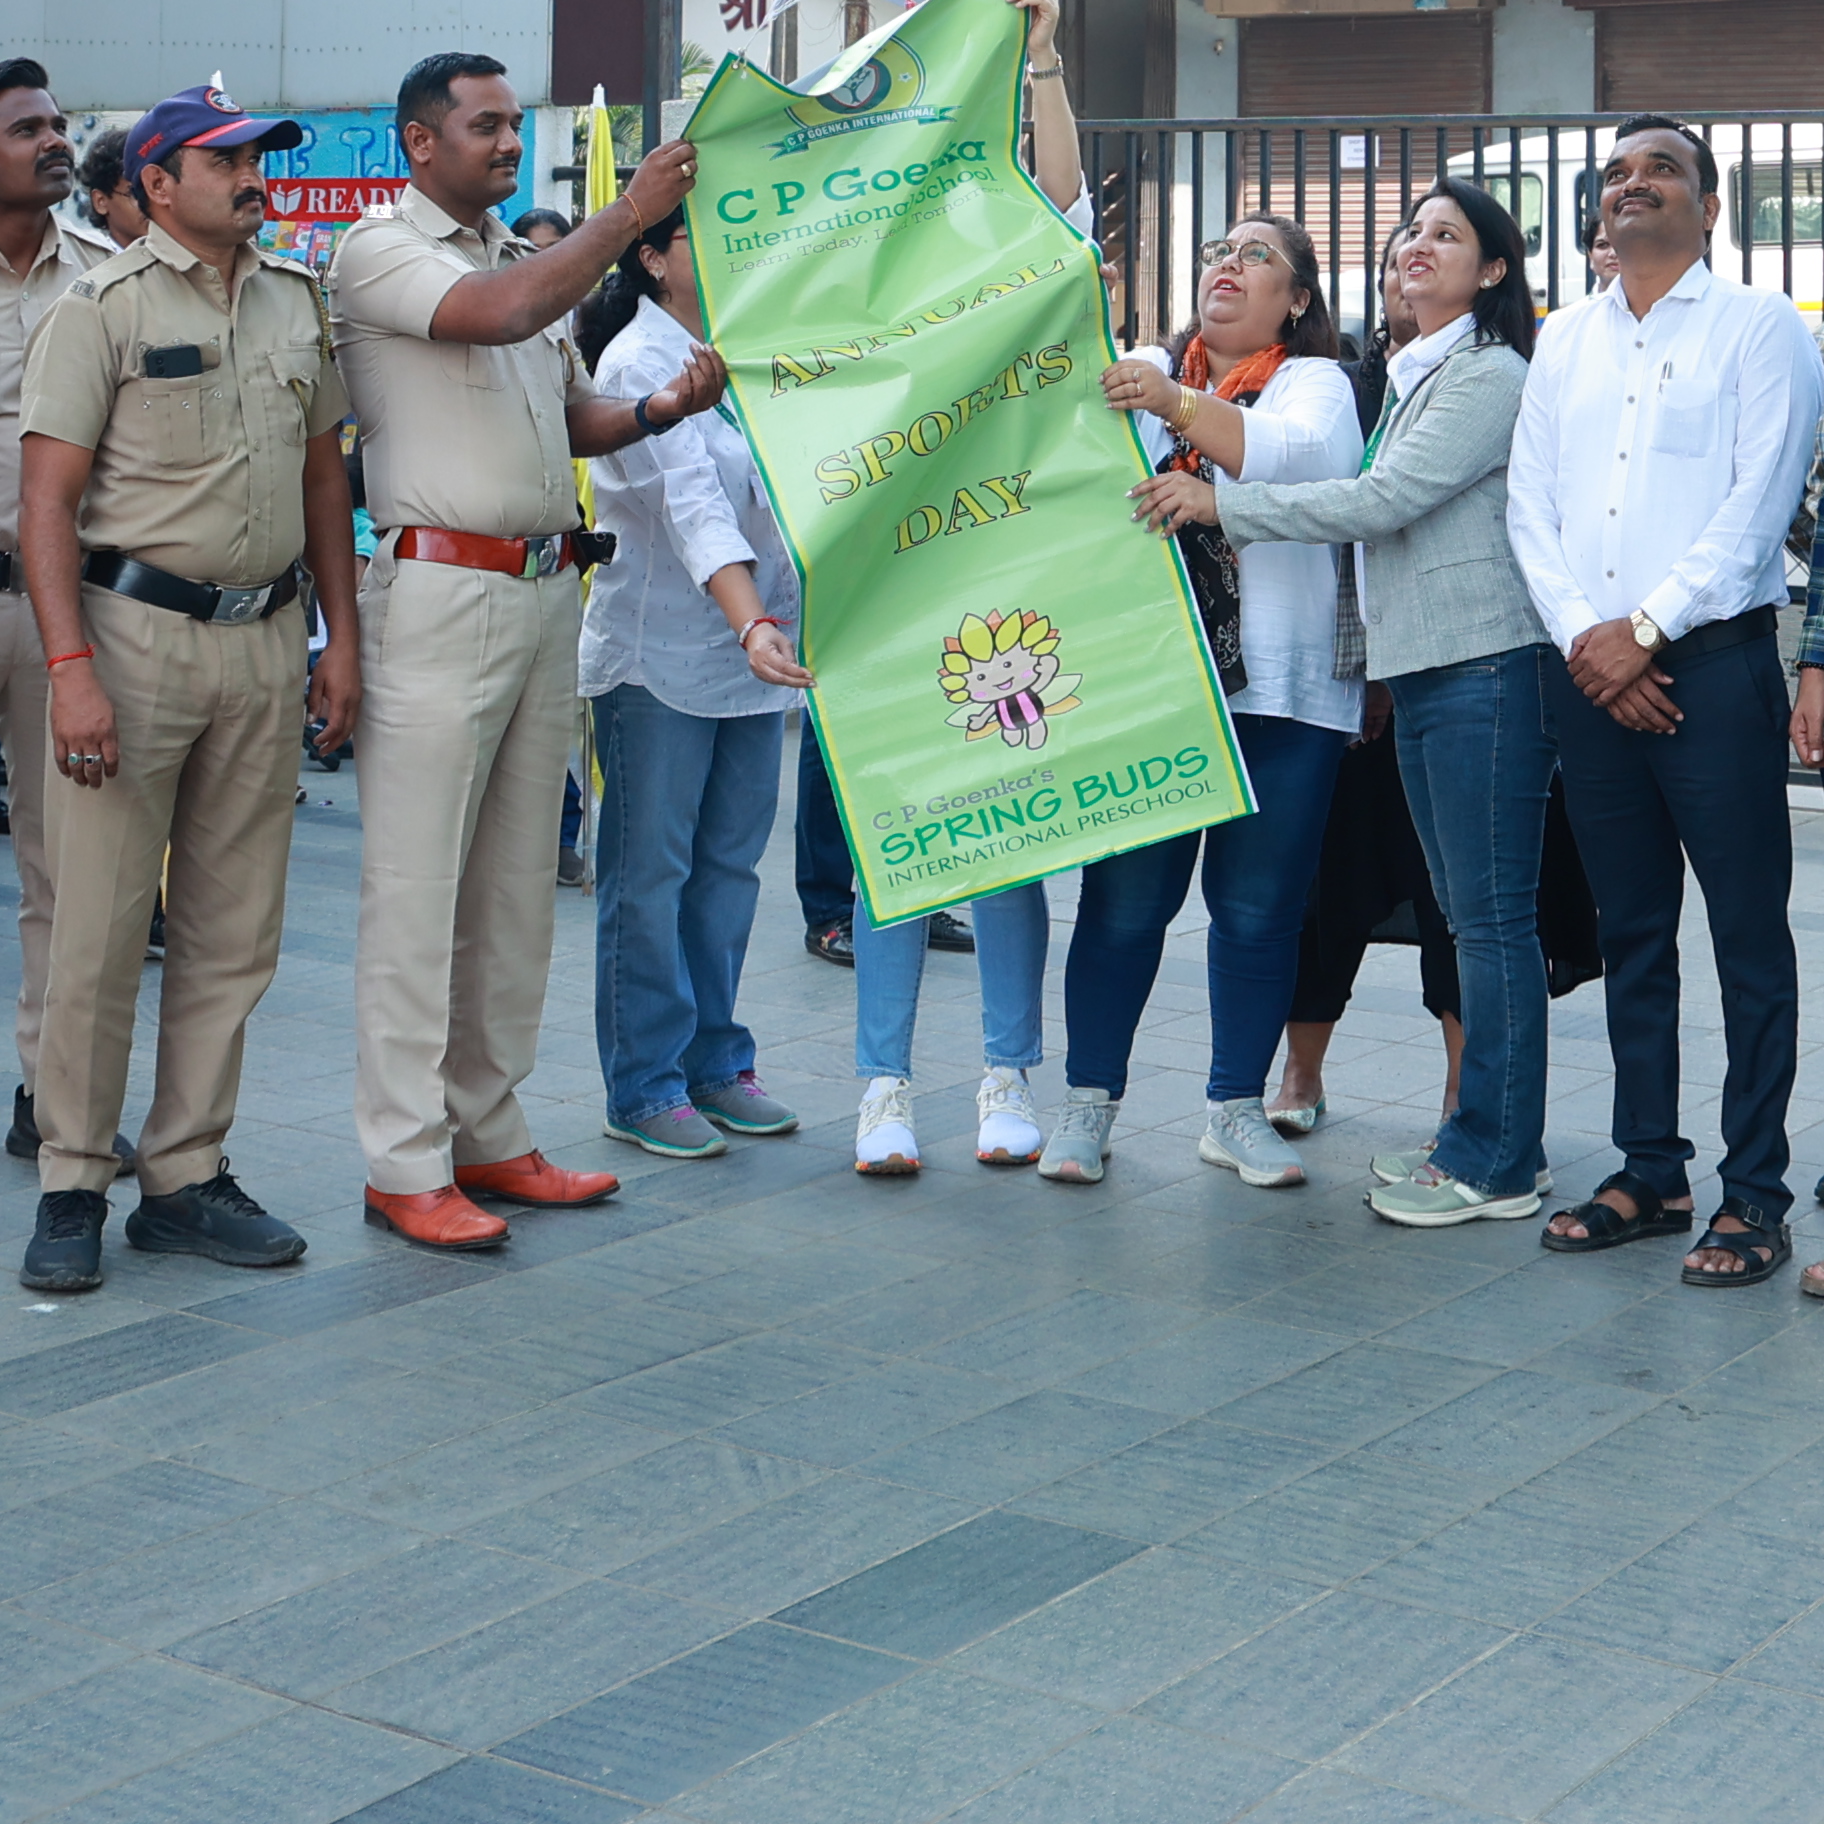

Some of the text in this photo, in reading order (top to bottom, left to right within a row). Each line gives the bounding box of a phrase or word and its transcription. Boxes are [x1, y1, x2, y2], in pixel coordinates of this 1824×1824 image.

[787, 107, 936, 146] C P GOENKA INTERNATIONAL
[306, 186, 405, 214] READ
[716, 140, 988, 224] C P Goeka
[728, 249, 791, 274] Learn
[770, 258, 1066, 399] ANNUAL
[814, 340, 1073, 505] SPORTS
[893, 470, 1032, 555] DAY
[872, 768, 1055, 831] C P Goenka's
[880, 746, 1209, 866] SPRING BUDS
[887, 779, 1217, 889] INTERNATIONAL PRESCHOOL
